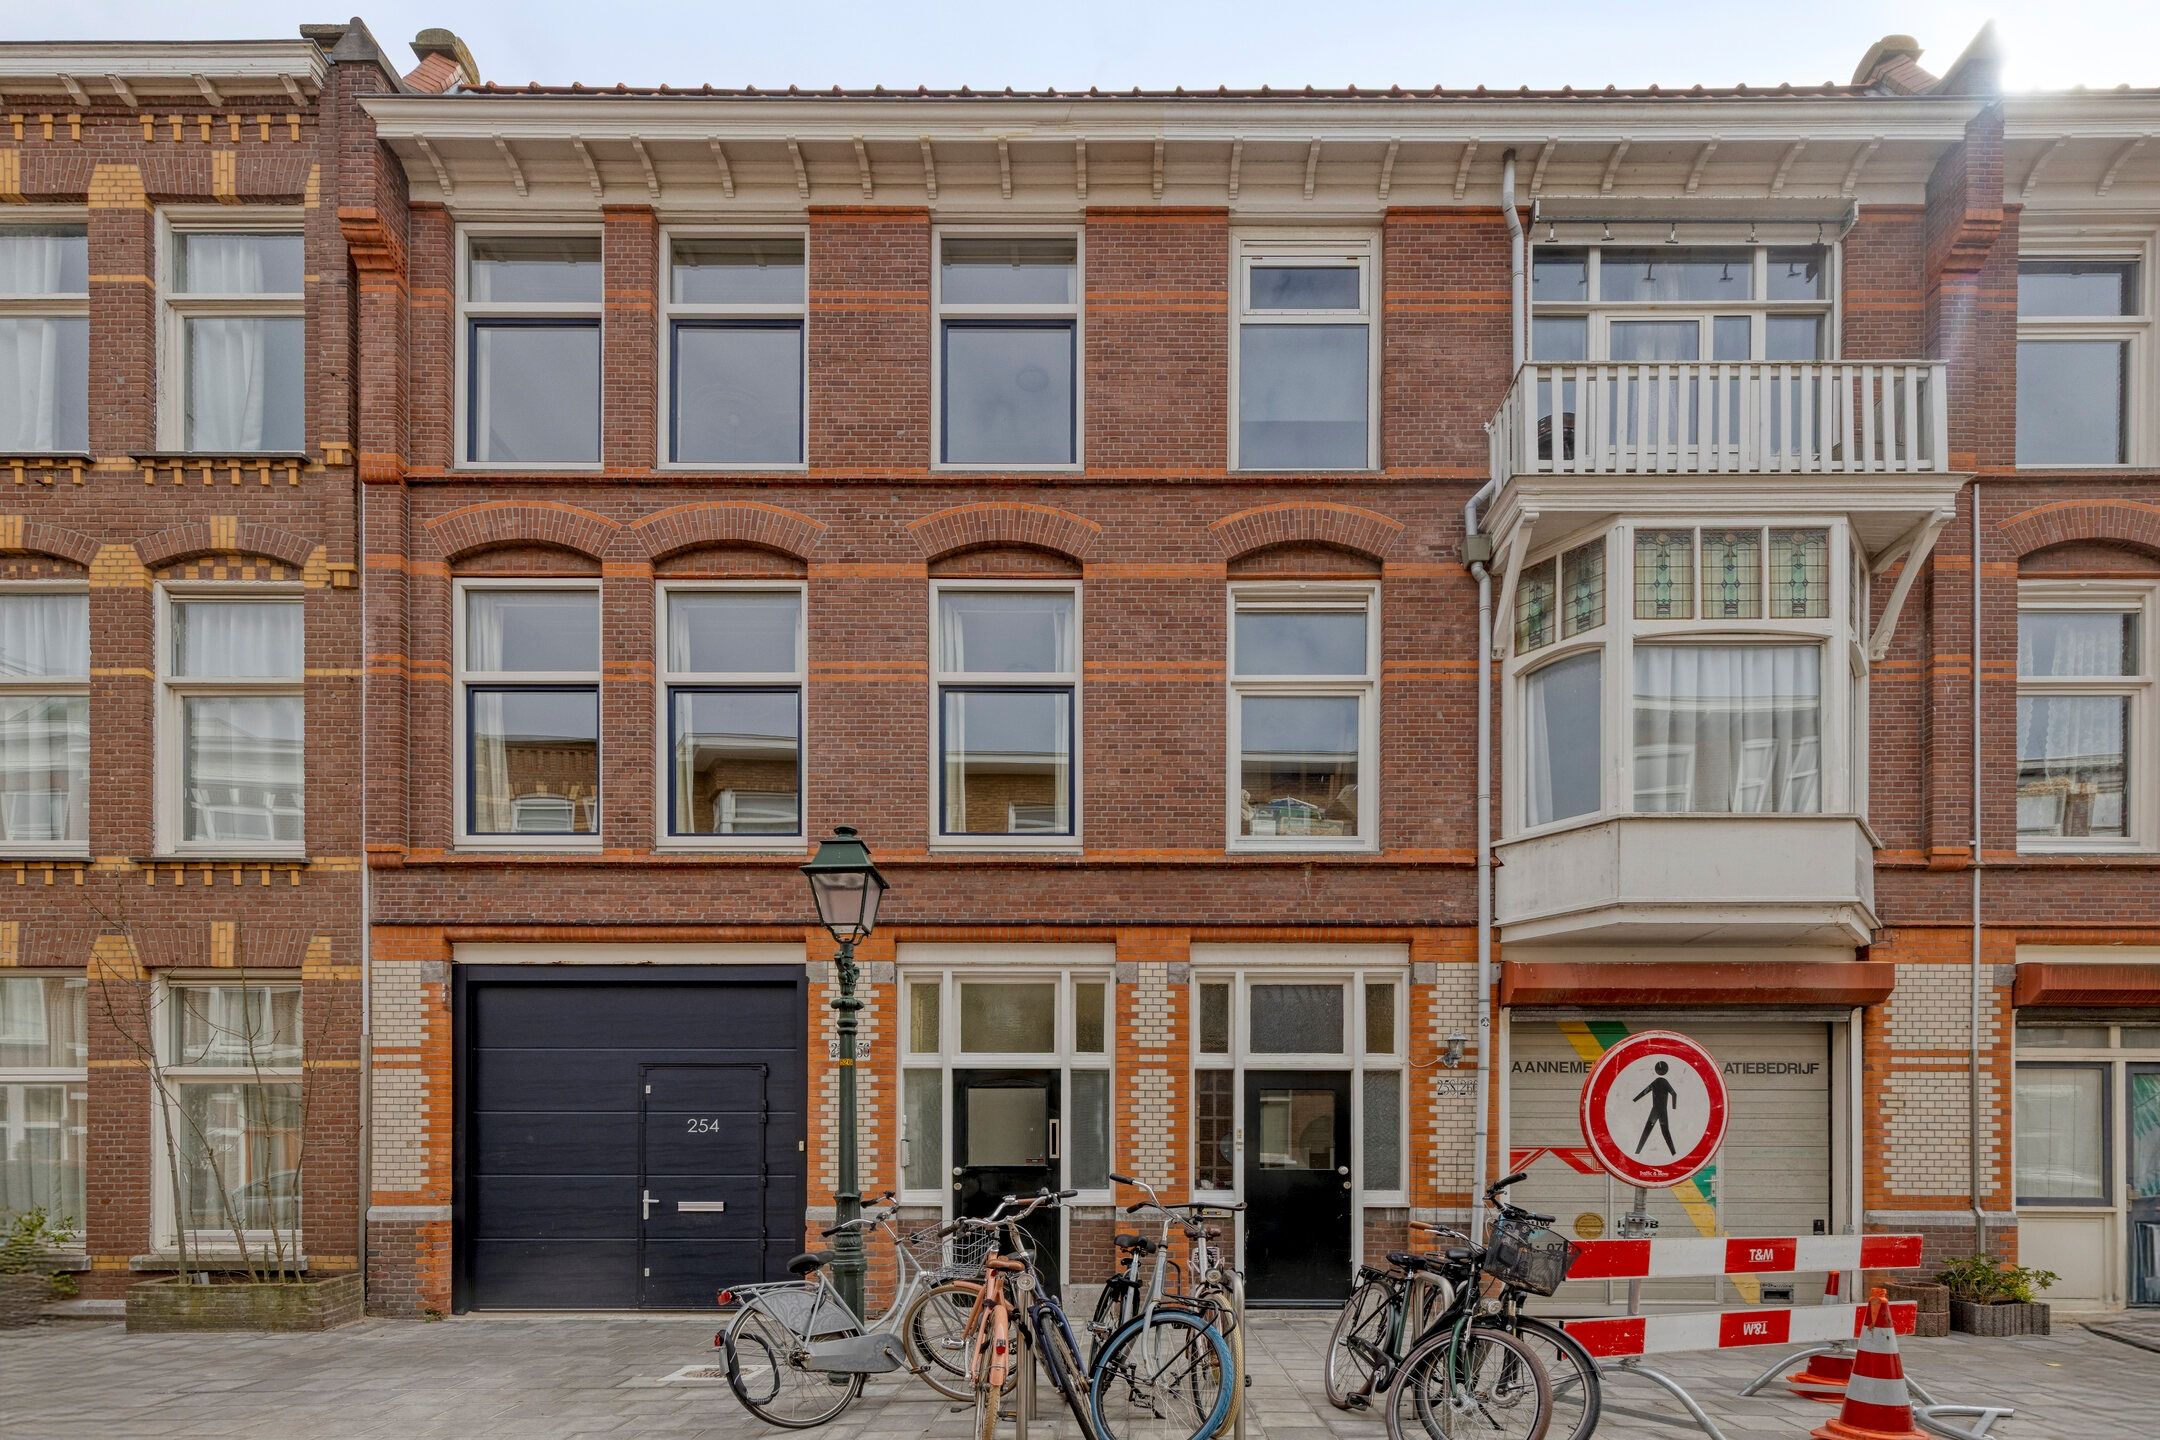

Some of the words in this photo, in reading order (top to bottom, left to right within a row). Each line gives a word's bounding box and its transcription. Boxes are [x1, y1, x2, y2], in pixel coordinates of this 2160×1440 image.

[1511, 1061, 1596, 1074] AANNEME
[1723, 1062, 1820, 1075] ATIEBEDRIJF
[1437, 1079, 1457, 1096] 258
[687, 1118, 720, 1133] 254
[1748, 1248, 1774, 1262] T&M
[1743, 1321, 1768, 1336] T&M
